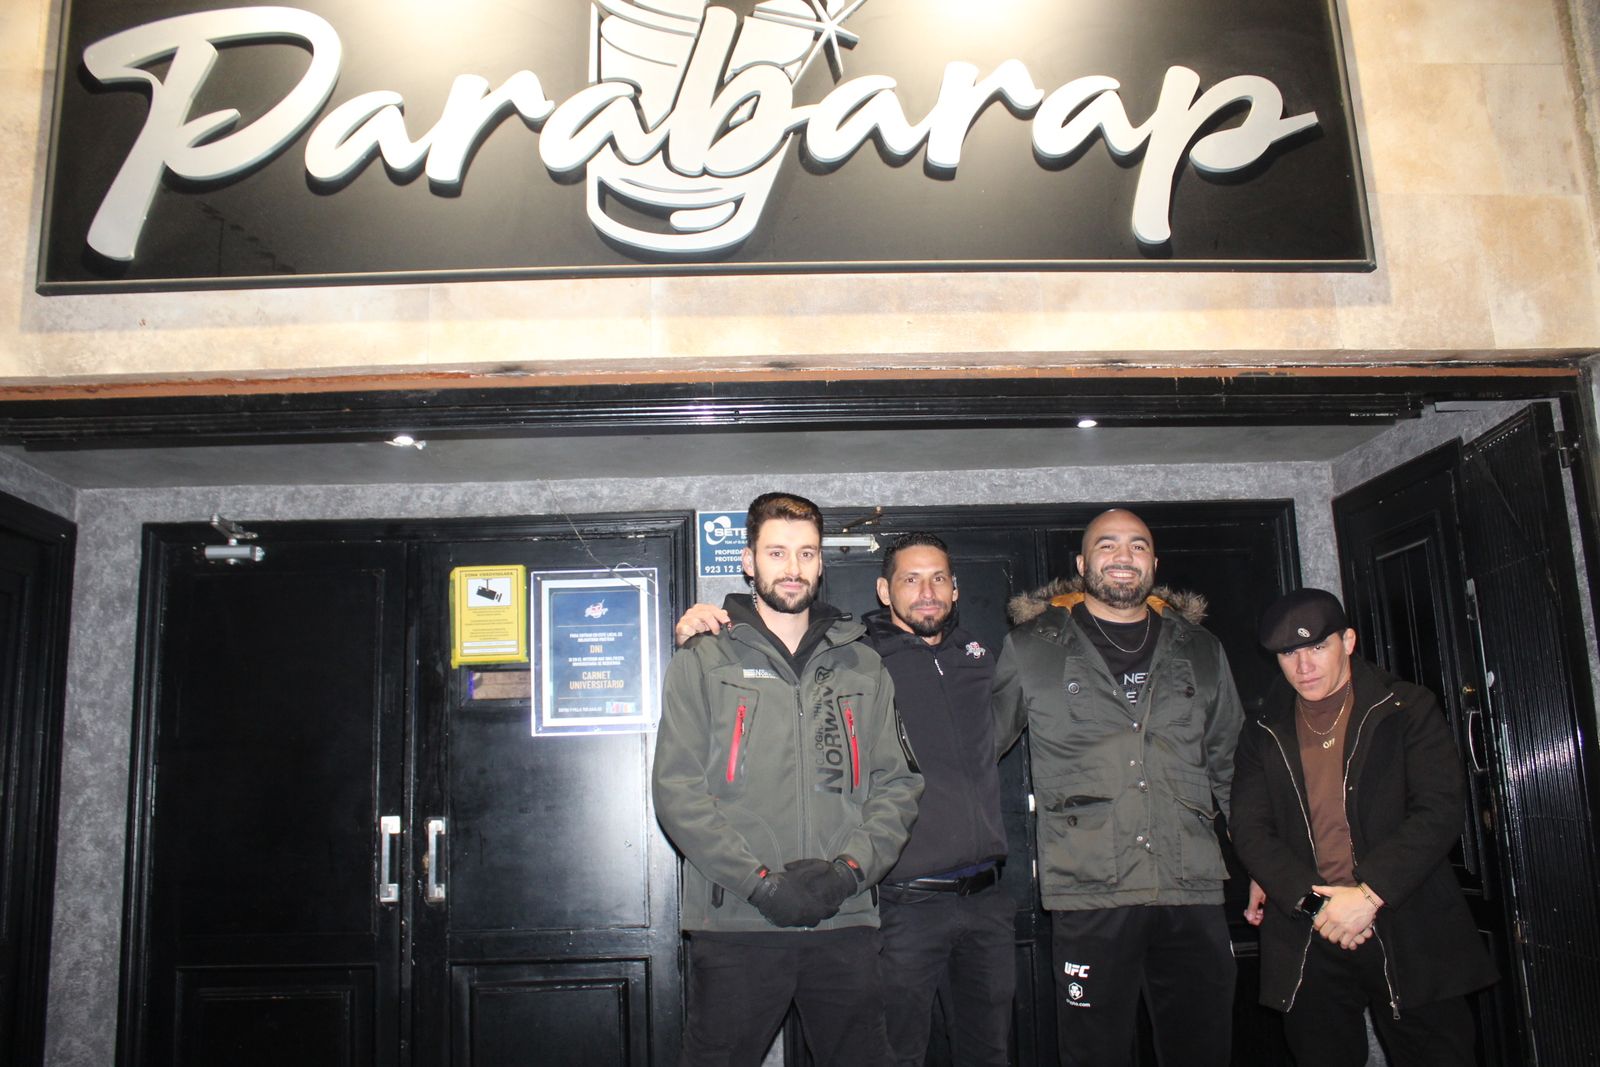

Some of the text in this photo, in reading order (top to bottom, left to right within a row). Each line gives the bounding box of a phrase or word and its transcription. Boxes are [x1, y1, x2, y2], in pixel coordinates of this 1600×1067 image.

[83, 5, 1319, 260] Parabarap
[704, 565, 743, 573] 923 12 5
[590, 644, 603, 654] DNI
[582, 670, 611, 680] CARNET
[1123, 672, 1149, 685] NE
[569, 679, 624, 690] UNIVERSITARIO
[1064, 961, 1090, 978] UFC
